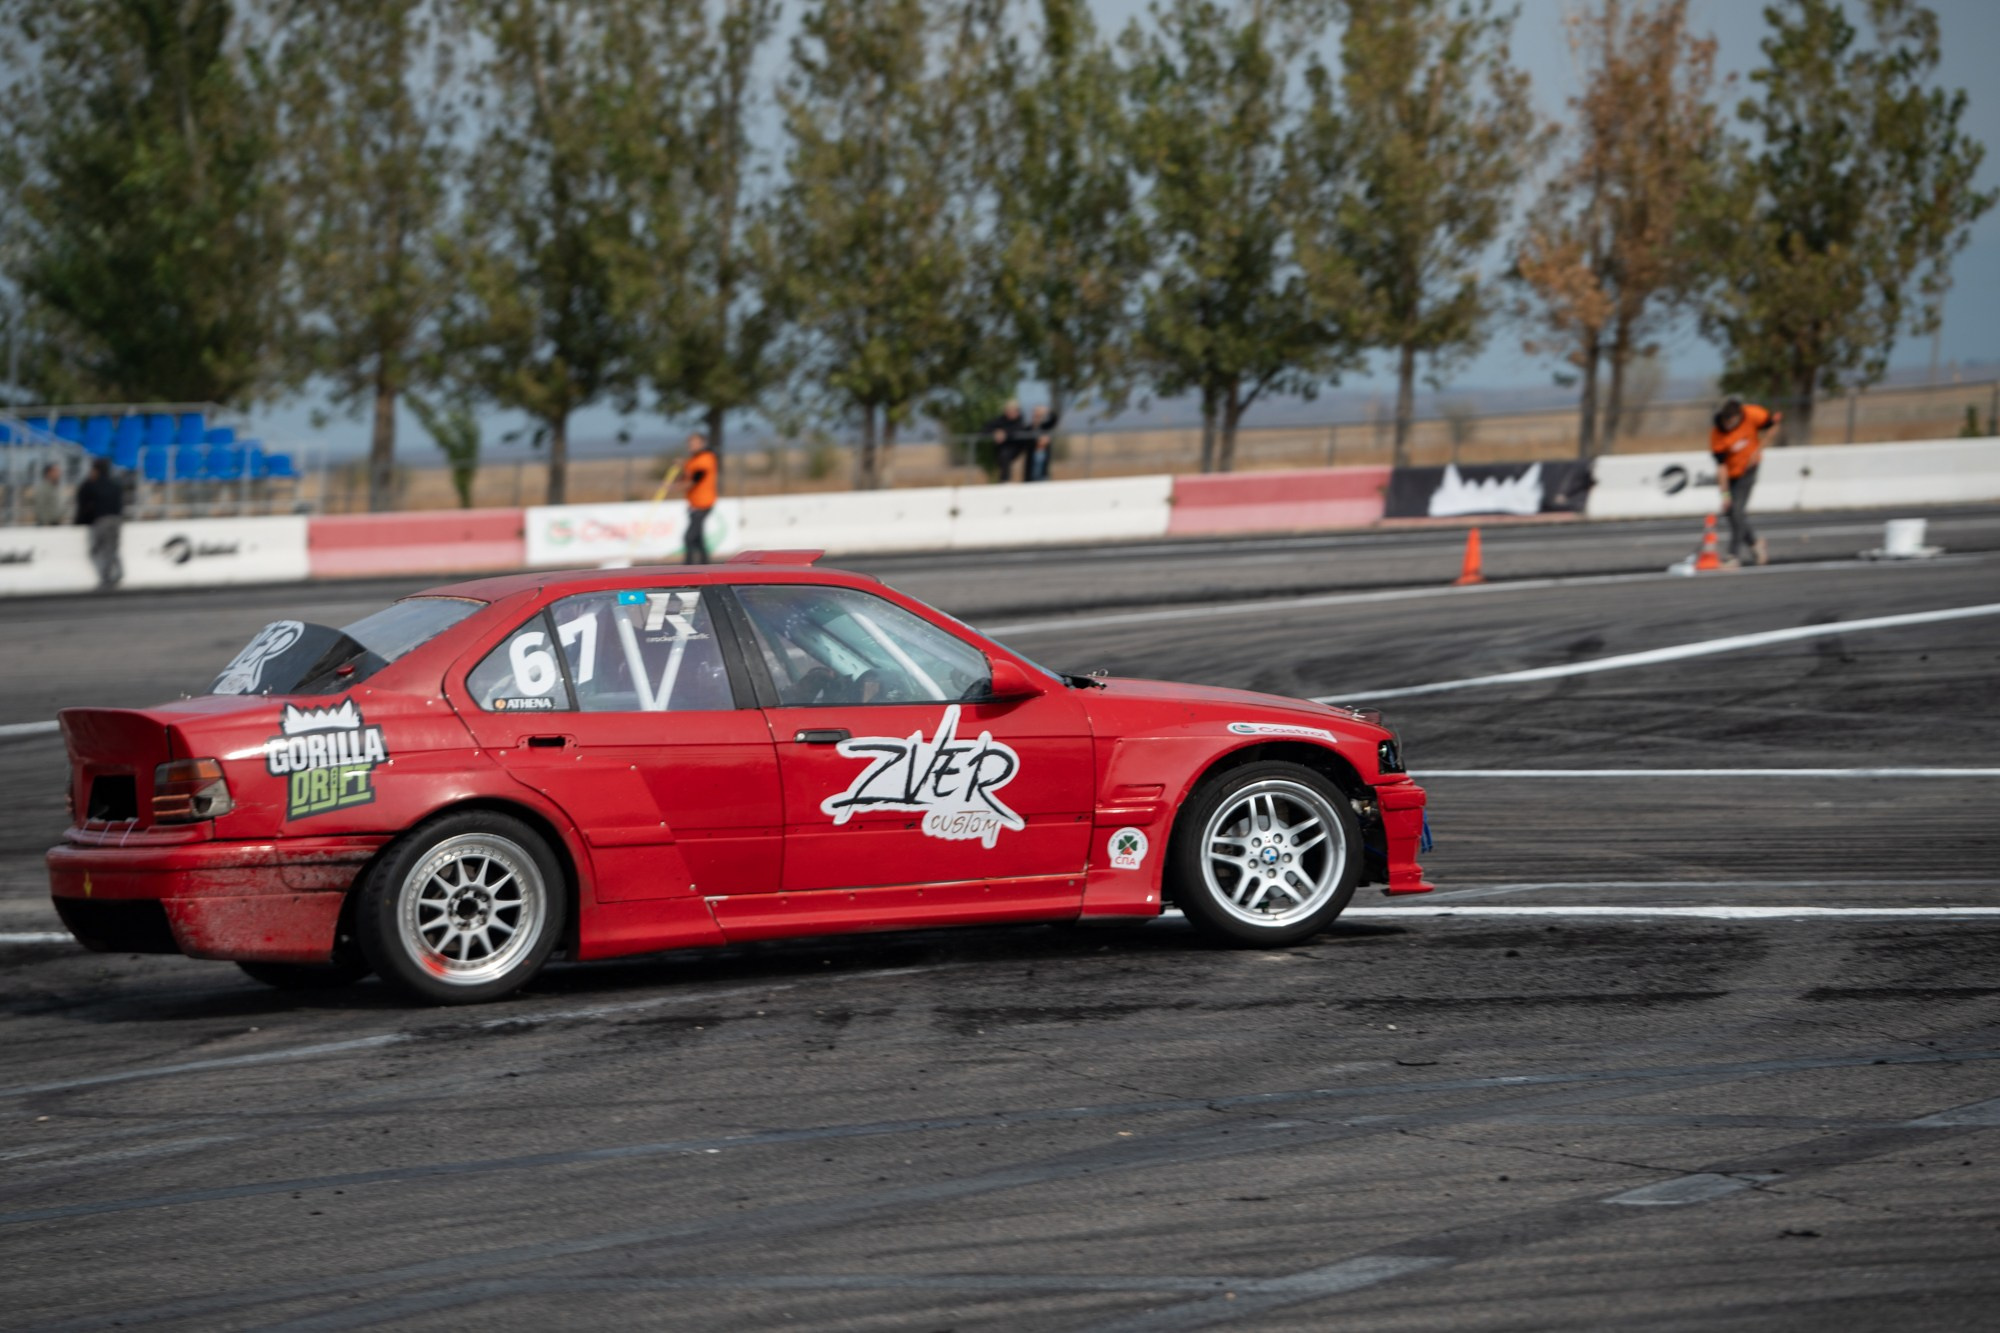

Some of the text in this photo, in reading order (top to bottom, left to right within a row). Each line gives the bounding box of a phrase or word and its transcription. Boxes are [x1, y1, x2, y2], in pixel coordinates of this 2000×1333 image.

[509, 612, 598, 697] 67
[506, 698, 553, 709] ATHENA
[268, 728, 386, 774] GORILLA
[1258, 726, 1328, 738] Castrol
[831, 708, 1018, 823] ZVER
[291, 763, 372, 816] DRIFT
[930, 810, 999, 840] CUSTOM
